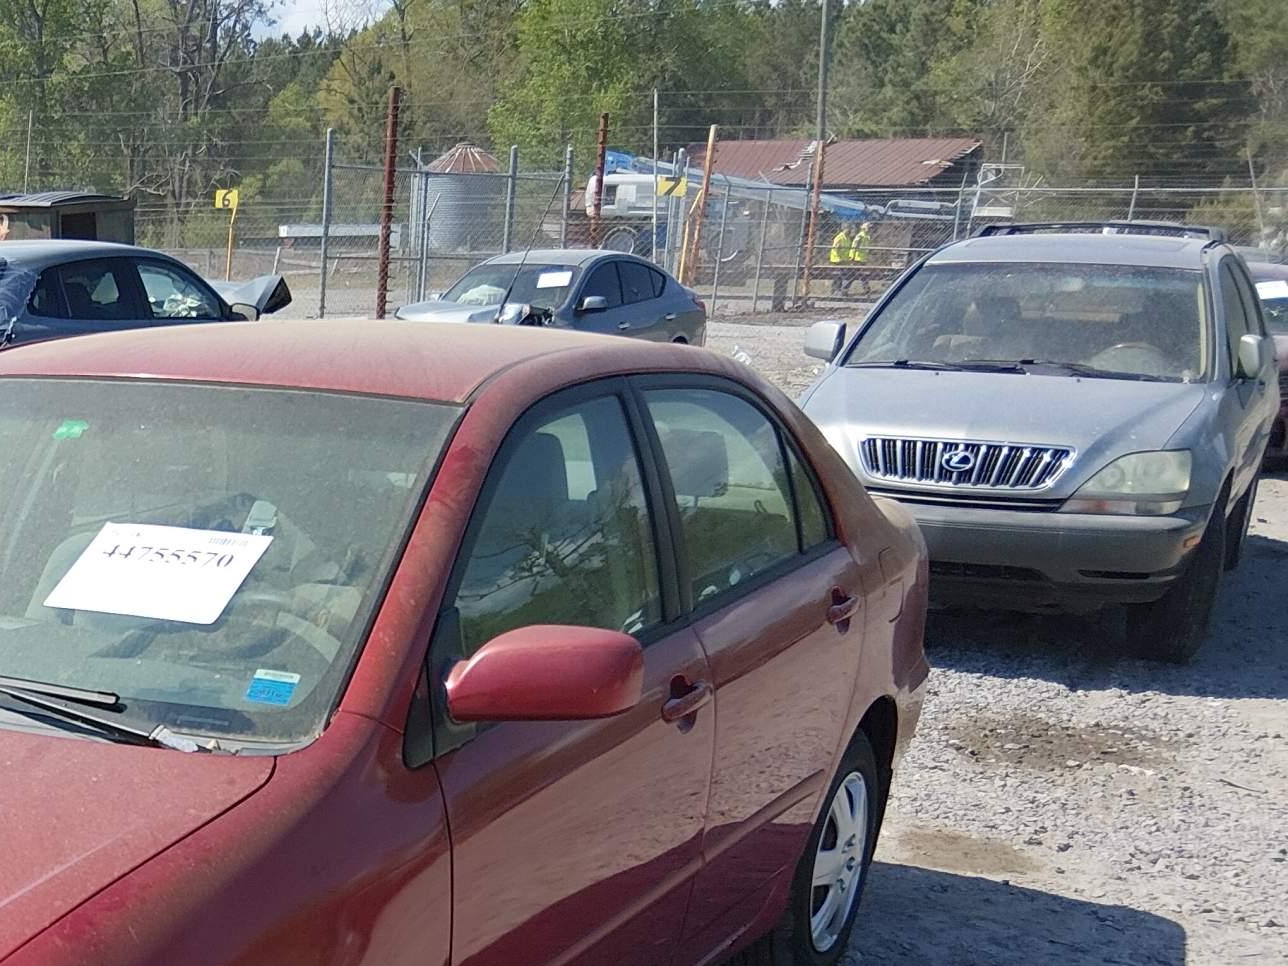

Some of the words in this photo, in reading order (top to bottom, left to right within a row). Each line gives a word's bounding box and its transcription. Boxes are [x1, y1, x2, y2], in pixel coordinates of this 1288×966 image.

[664, 176, 682, 196] 7
[222, 189, 233, 208] 6
[103, 544, 235, 568] 44755570
